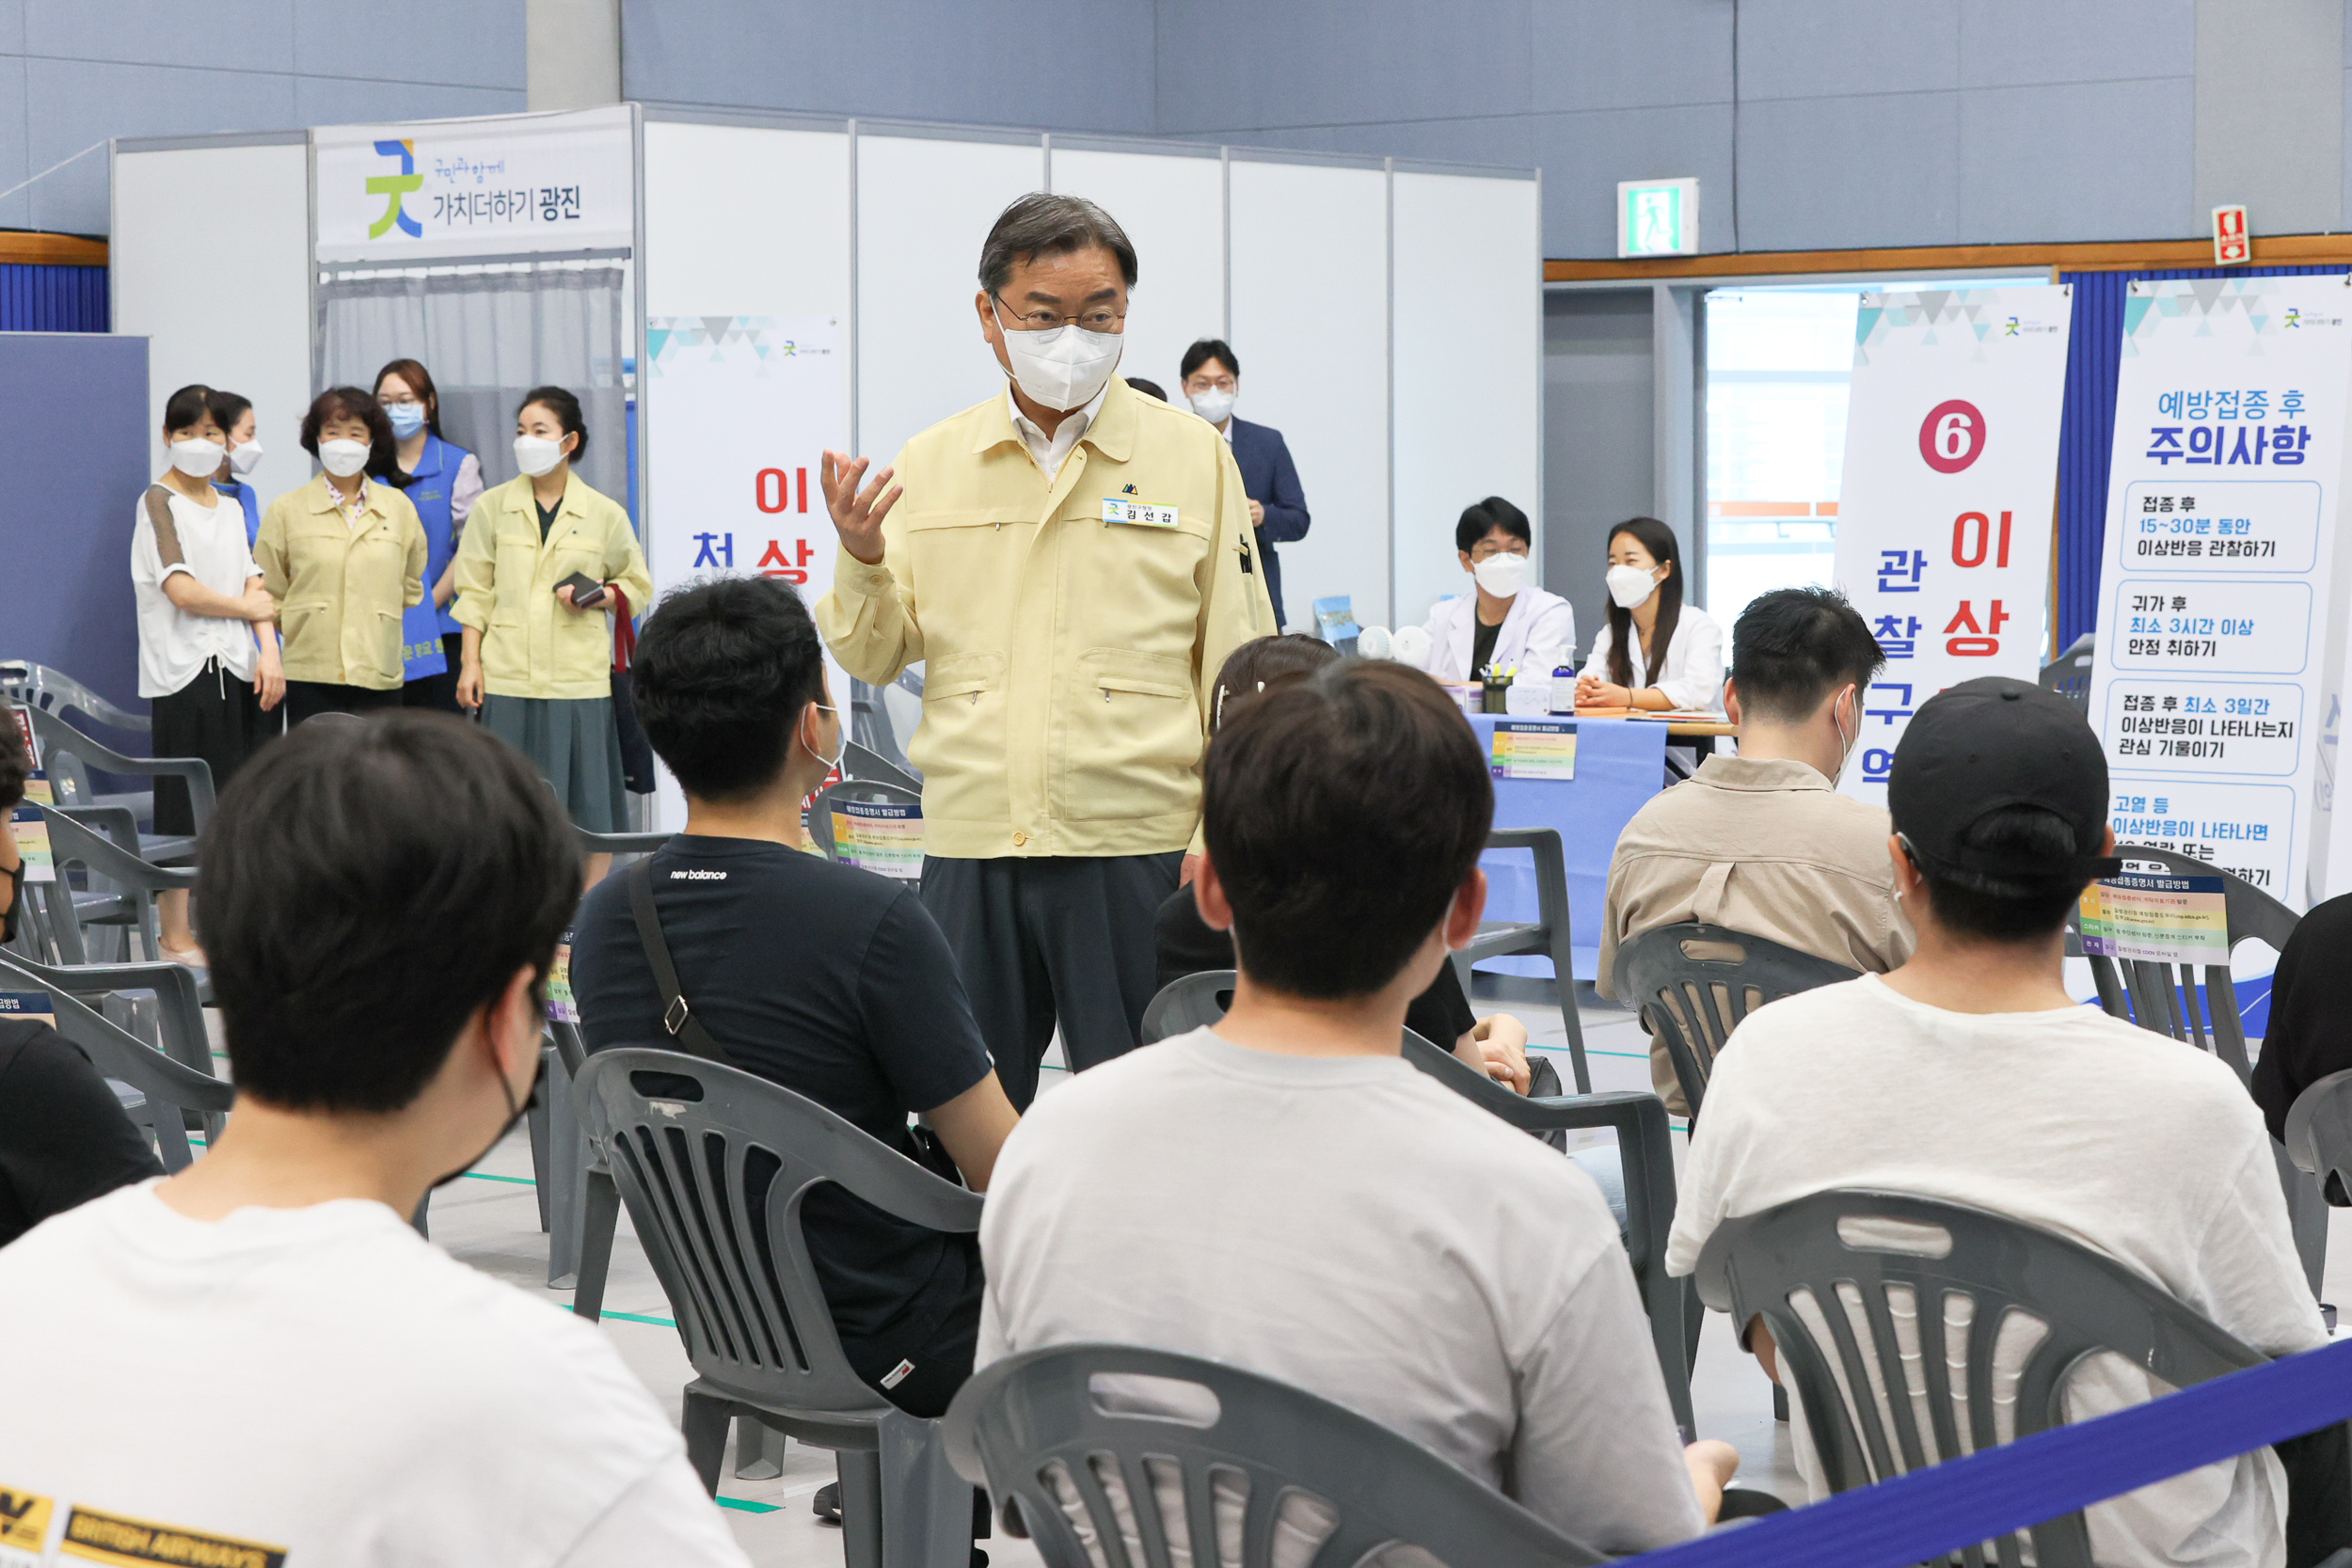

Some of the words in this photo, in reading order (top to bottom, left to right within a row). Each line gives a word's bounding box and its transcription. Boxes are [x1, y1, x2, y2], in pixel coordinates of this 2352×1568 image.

[434, 188, 533, 225] 가치더하기
[539, 185, 580, 221] 광진
[2159, 389, 2269, 420] 예방접종
[2279, 389, 2305, 420] 후
[2146, 424, 2312, 466] 주의사항
[2143, 496, 2174, 513] 접종
[2180, 497, 2196, 513] 후
[2139, 518, 2211, 534] 15~30분
[2217, 518, 2250, 534] 동안
[2137, 539, 2202, 556] 이상반응
[2209, 540, 2276, 557] 관찰하기
[2132, 595, 2165, 611] 귀가
[2171, 595, 2187, 611] 후
[2130, 617, 2162, 633] 최소
[2169, 618, 2215, 635] 3시간
[2221, 619, 2254, 636] 이상
[2129, 639, 2160, 656] 안정
[2167, 640, 2217, 657] 취하기
[2123, 694, 2155, 712] 접종
[2162, 696, 2178, 712] 후
[2184, 696, 2217, 714] 최소
[2224, 698, 2270, 716] 3일간
[2122, 717, 2203, 736] 이상반응이
[2211, 720, 2294, 738] 나타나는지
[2119, 738, 2151, 755] 관심
[2159, 740, 2224, 758] 기울이기
[2114, 796, 2146, 814] 고열
[2153, 798, 2169, 815] 등
[2113, 817, 2195, 837] 이상반응이
[2201, 821, 2268, 841] 나타나면
[670, 871, 688, 879] new
[688, 869, 727, 879] balance
